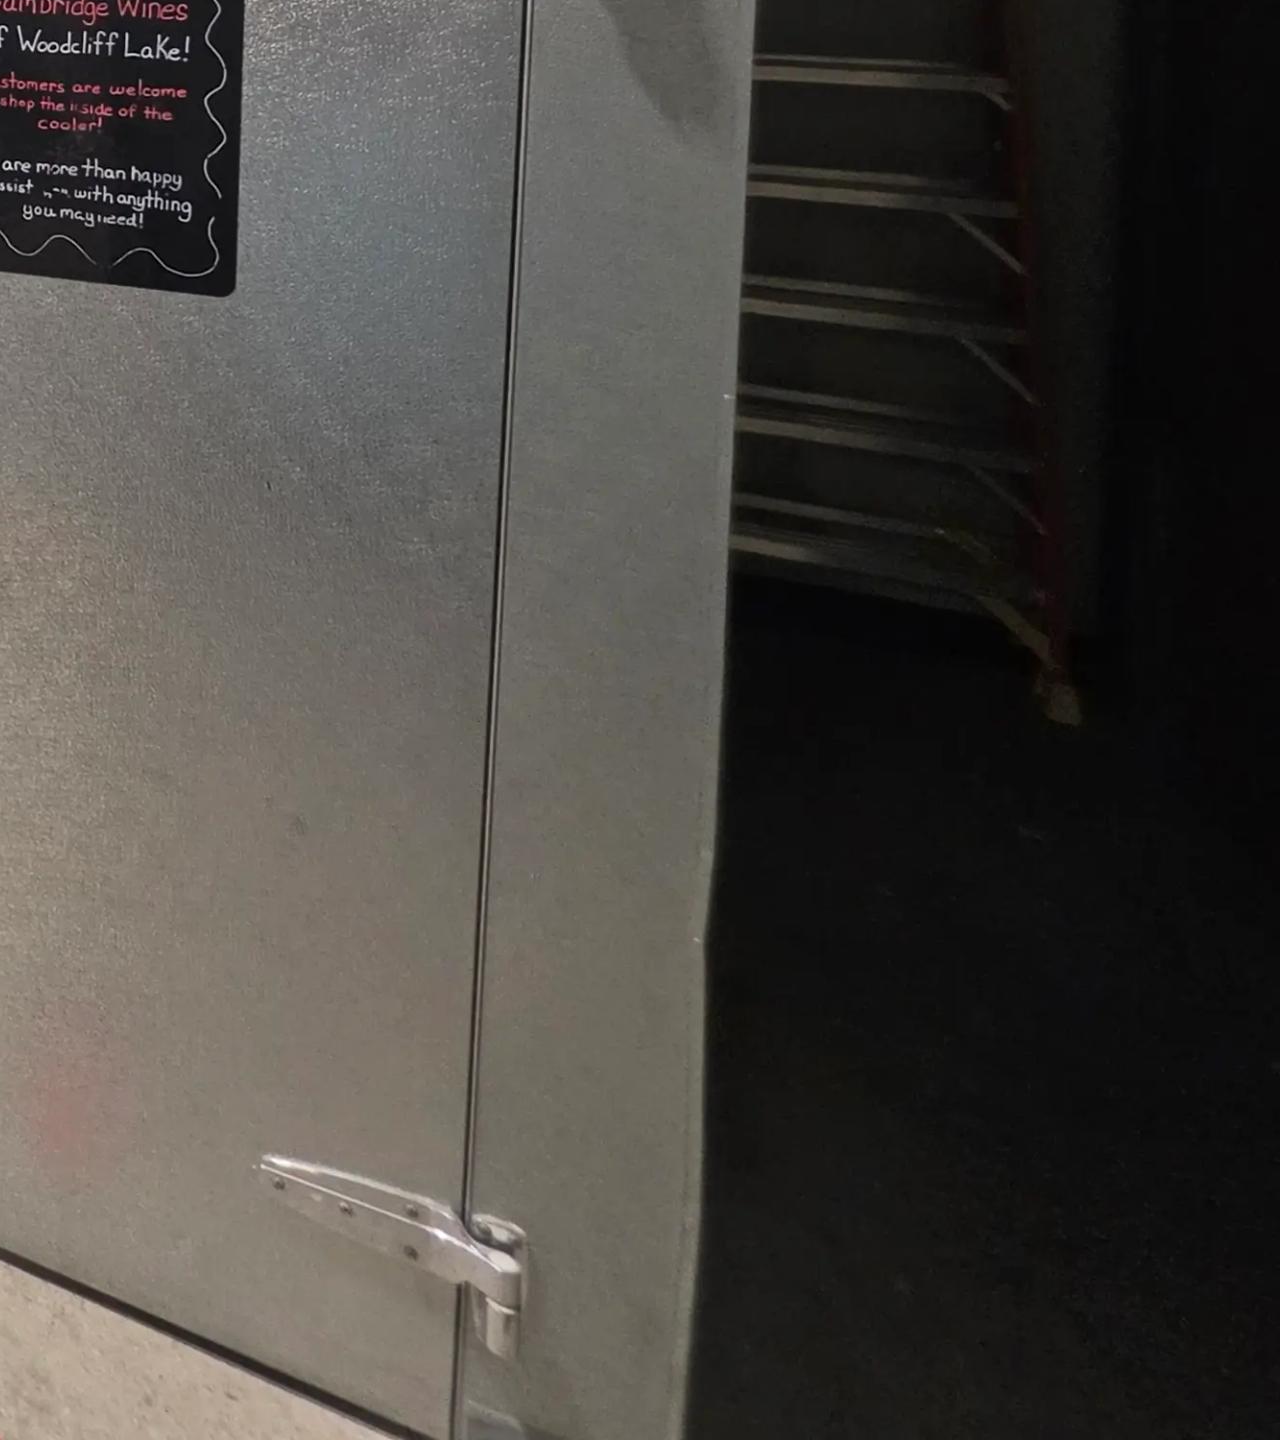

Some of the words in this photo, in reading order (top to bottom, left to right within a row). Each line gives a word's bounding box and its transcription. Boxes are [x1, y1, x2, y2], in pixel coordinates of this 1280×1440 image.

[17, 24, 119, 56] Woodcliff
[72, 83, 101, 95] are
[109, 78, 188, 99] welcome
[0, 94, 36, 112] shop
[40, 96, 65, 111] the
[118, 103, 138, 118] of
[144, 106, 174, 121] the
[37, 116, 102, 133] cooler!
[2, 159, 32, 173] are
[35, 162, 78, 177] more
[81, 158, 127, 181] than
[130, 164, 183, 192] happy
[22, 203, 57, 220] you
[59, 206, 95, 228] may
[73, 185, 114, 205] with
[116, 189, 193, 223] anything
